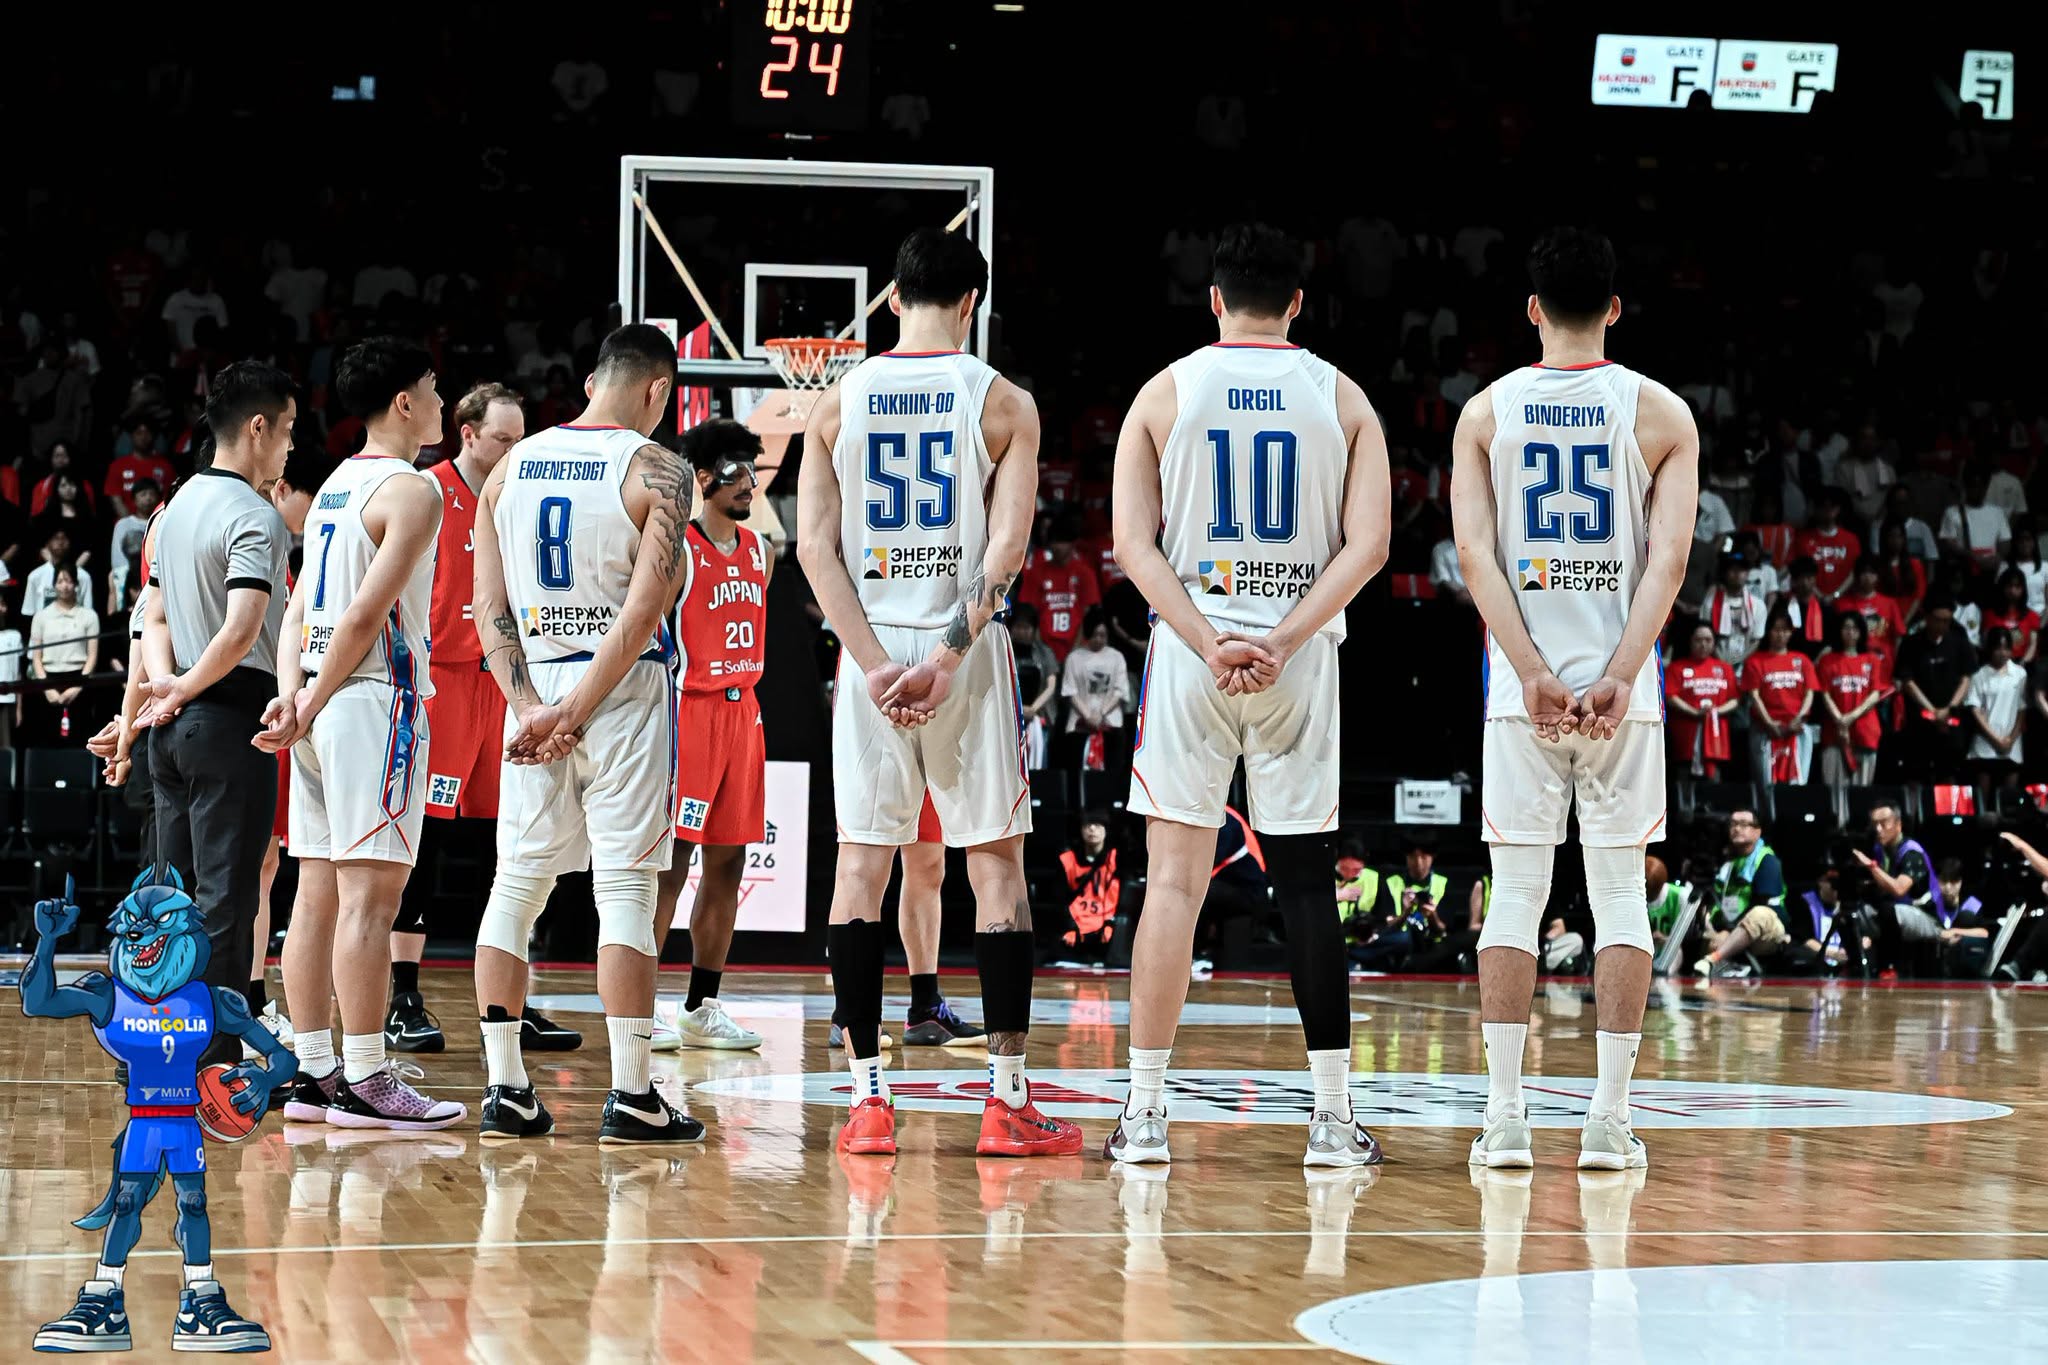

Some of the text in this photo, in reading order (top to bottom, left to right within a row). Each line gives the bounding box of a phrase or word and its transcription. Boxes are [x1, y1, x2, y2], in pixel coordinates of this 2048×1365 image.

[766, 0, 852, 33] 10:00
[1667, 45, 1704, 59] GATE
[1787, 50, 1825, 64] GATE
[760, 36, 842, 98] 24
[1670, 66, 1698, 102] F
[1791, 71, 1819, 107] F
[868, 392, 955, 415] ENKHIIN-OD
[1228, 388, 1286, 411] ORGIL
[1524, 404, 1606, 427] BINDERIYA
[518, 460, 608, 481] ERDENETSOGT
[866, 430, 956, 532] 55
[1206, 429, 1298, 544] 10
[1521, 442, 1615, 543] 25
[535, 496, 575, 592] 8
[891, 546, 963, 562] ЭНЕРЖИ
[312, 523, 336, 611] 7
[891, 562, 958, 580] РЕСУРС
[1235, 560, 1316, 580] ЭНЕРЖИ
[1550, 558, 1623, 575] ЭНЕРЖИ
[708, 580, 762, 610] JAPAN
[1236, 580, 1310, 599] РЕСУРС
[1551, 576, 1618, 591] РЕСУРС
[541, 606, 613, 621] ЭНЕРЖИ
[541, 622, 608, 637] РЕСУРС
[725, 620, 754, 649] 20
[1318, 1113, 1329, 1122] 33
